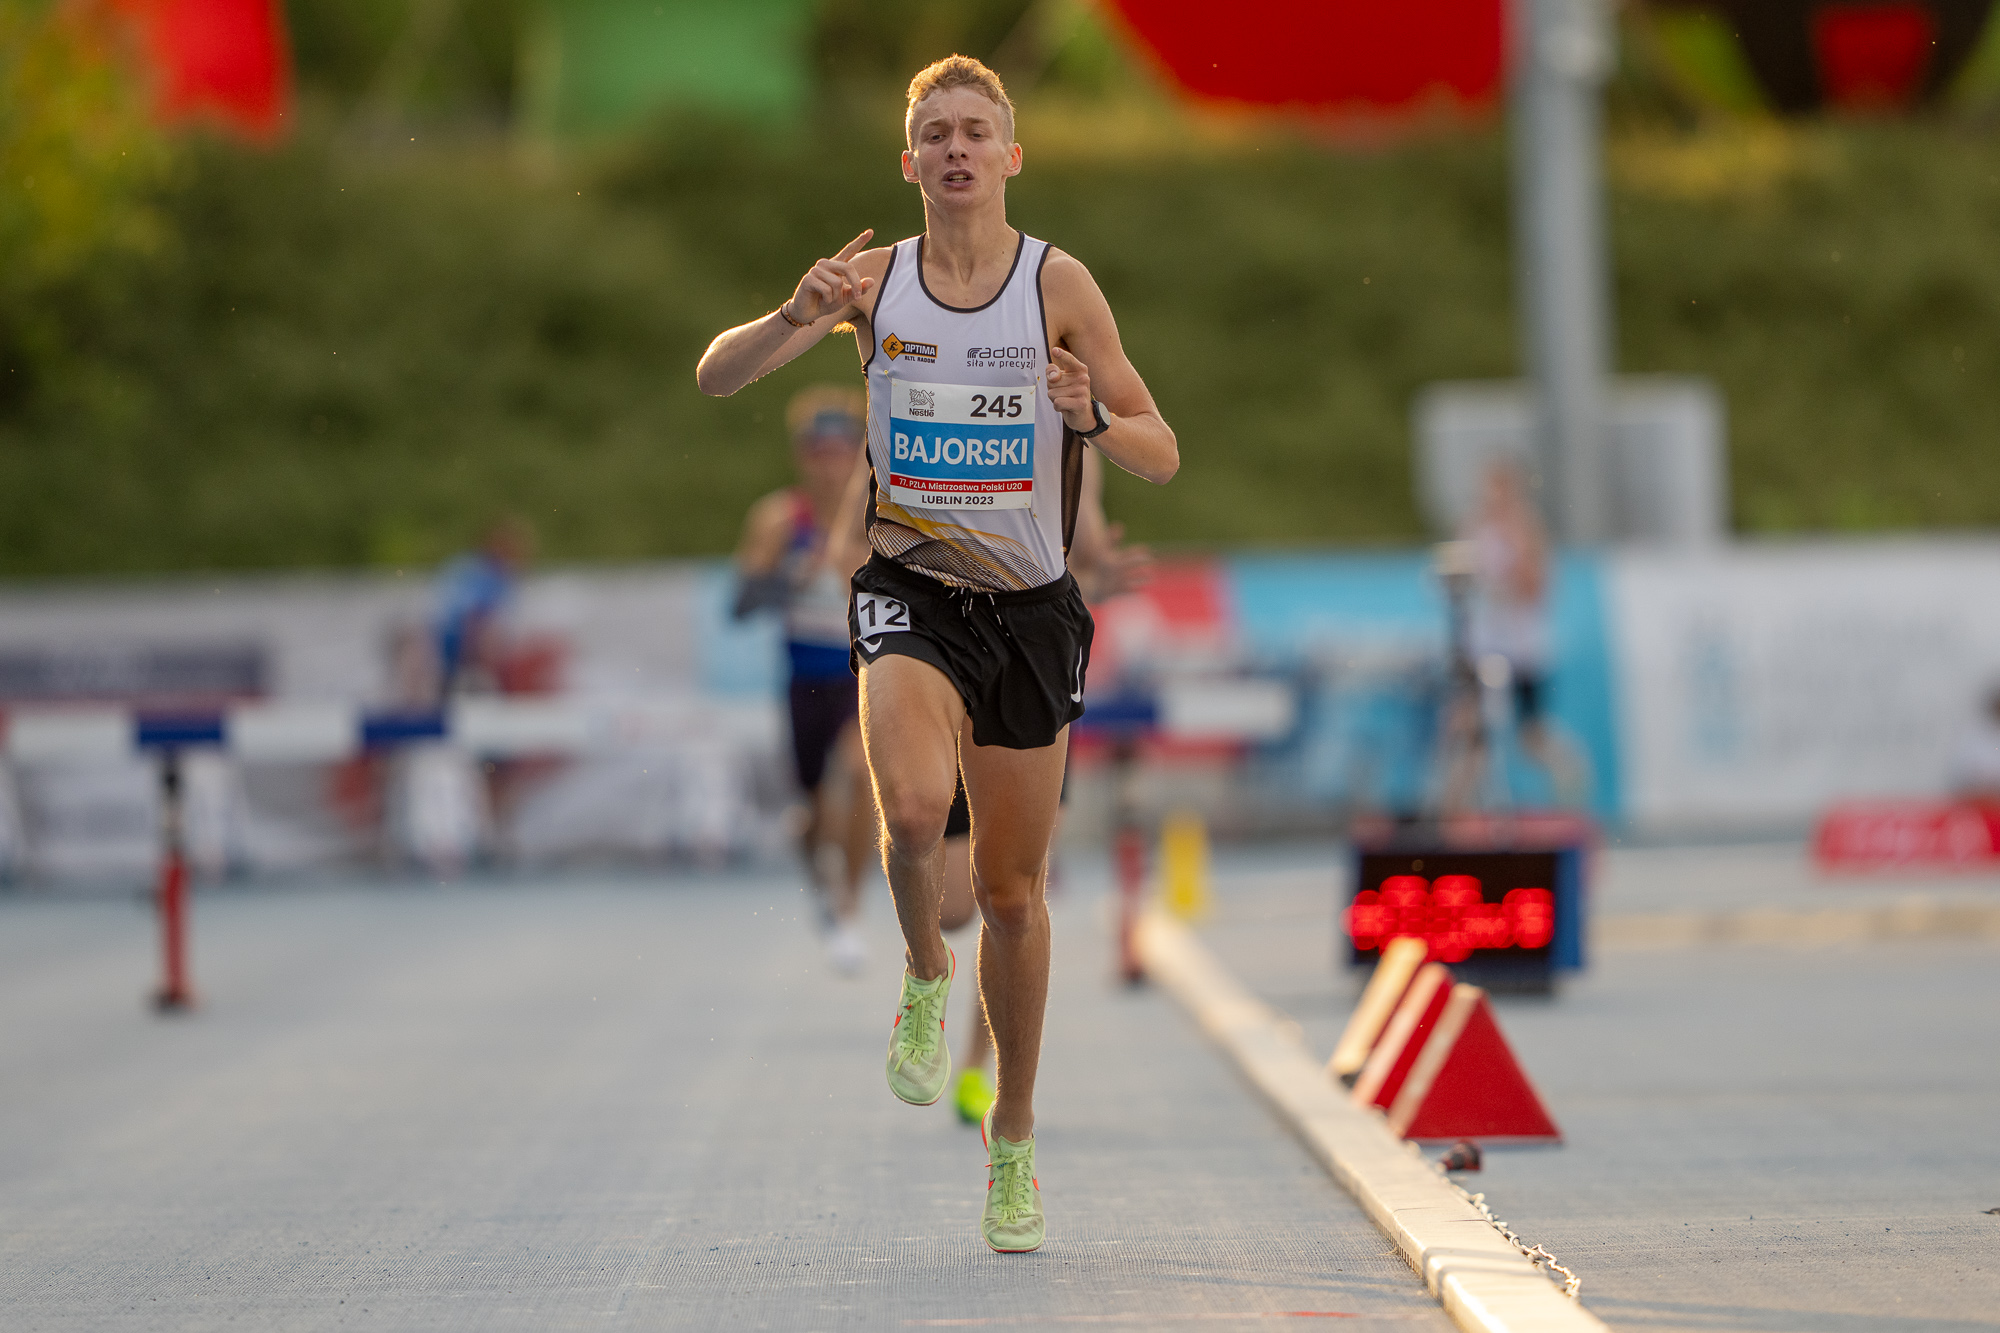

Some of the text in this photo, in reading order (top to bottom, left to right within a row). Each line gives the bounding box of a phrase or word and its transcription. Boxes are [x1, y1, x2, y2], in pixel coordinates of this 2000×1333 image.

[904, 343, 936, 356] OPTIMA
[966, 359, 984, 367] siła
[999, 360, 1036, 370] precyzji
[970, 394, 1023, 418] 245
[894, 432, 1028, 466] BAJORSKI
[899, 477, 1023, 491] 77. PZLA Mistrzostwa Polski U20
[921, 494, 994, 505] LUBLIN 2023
[860, 599, 908, 628] 12
